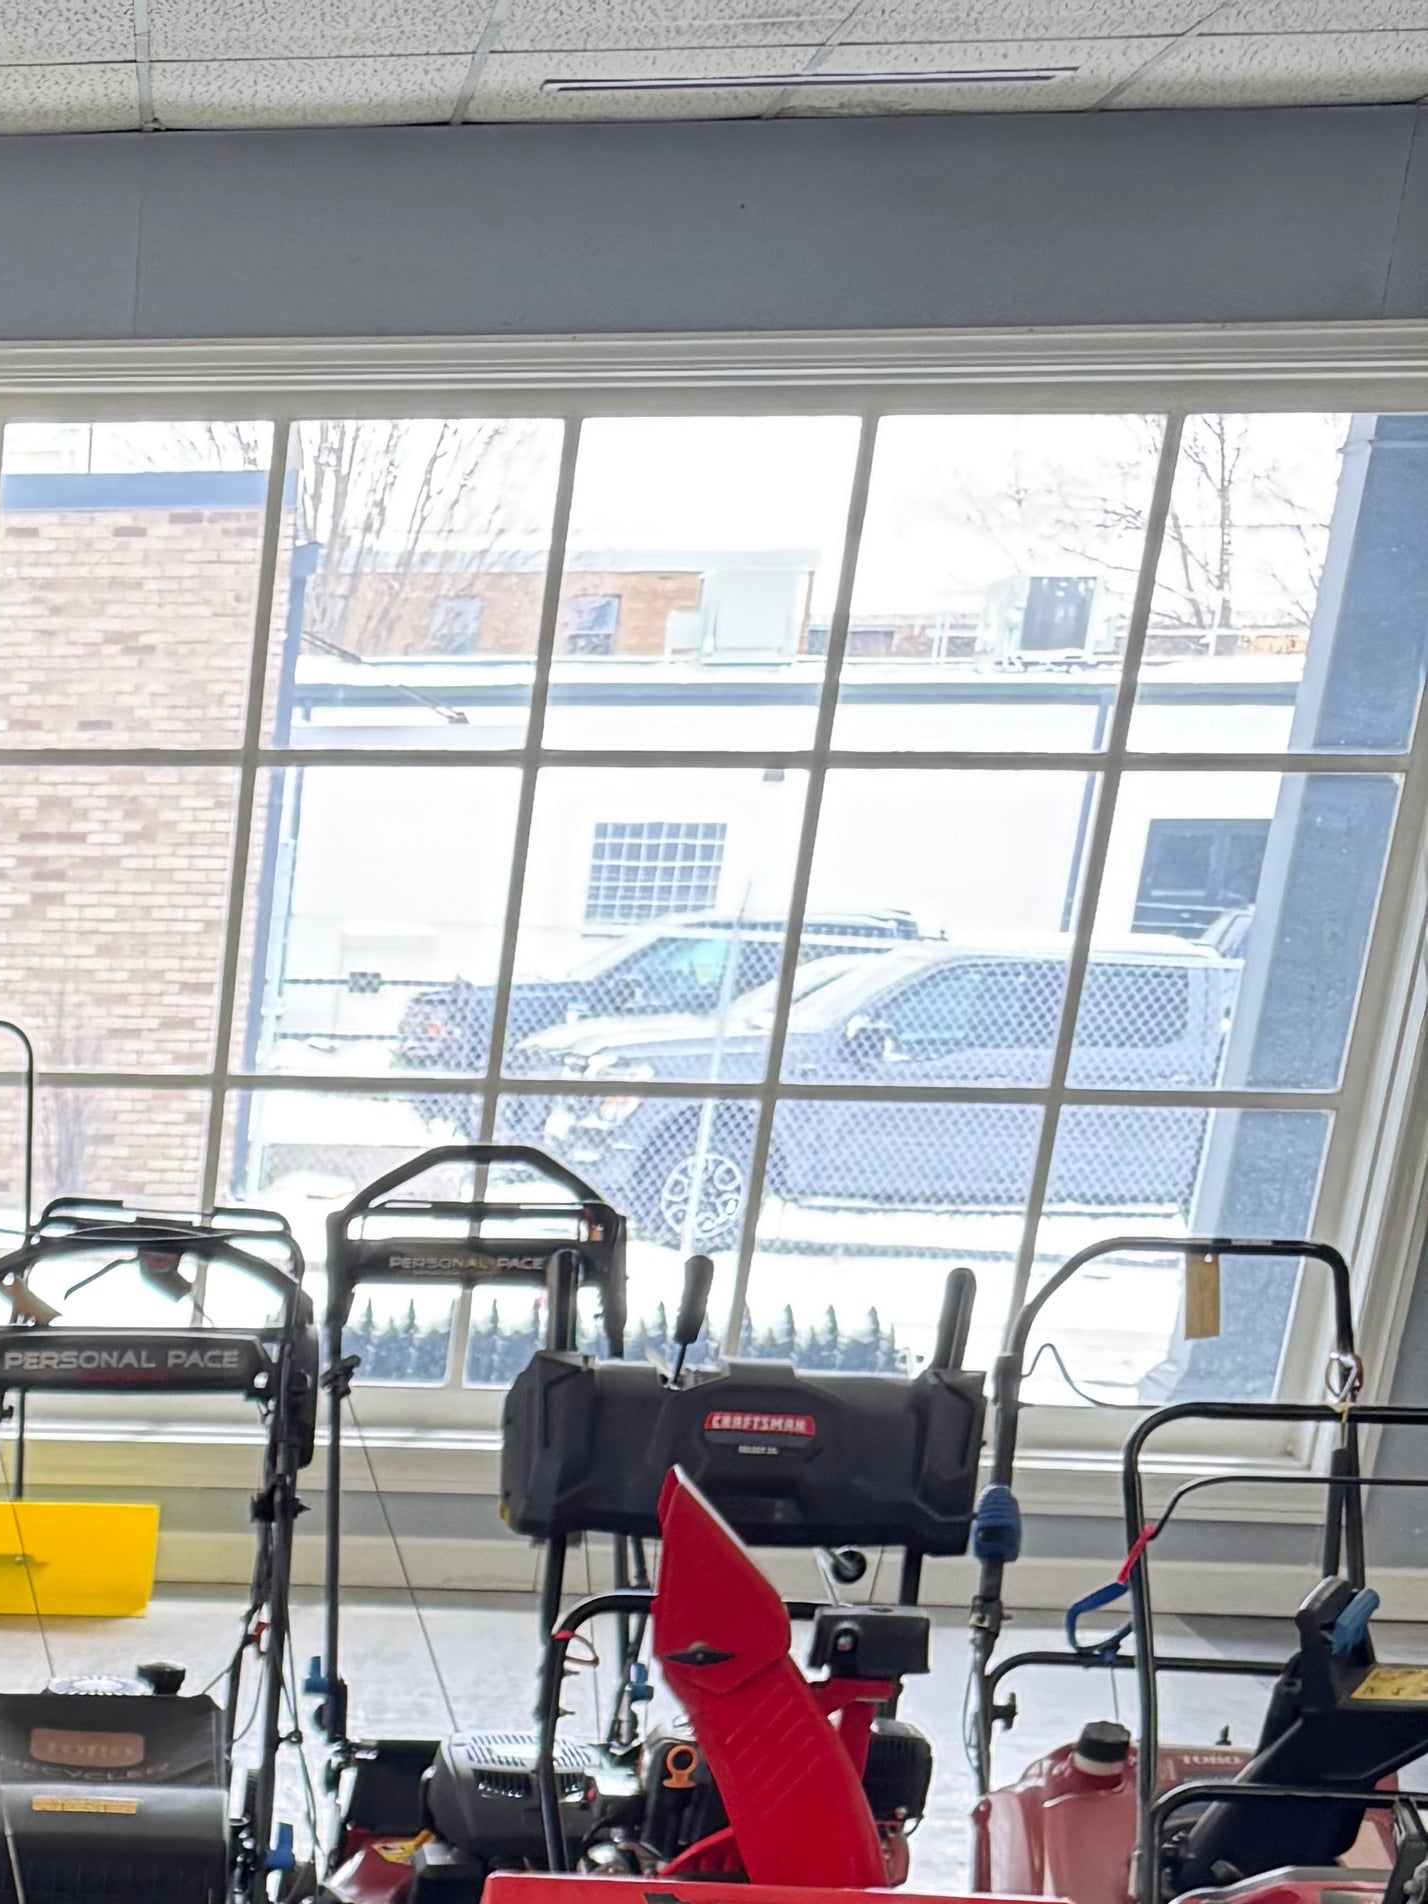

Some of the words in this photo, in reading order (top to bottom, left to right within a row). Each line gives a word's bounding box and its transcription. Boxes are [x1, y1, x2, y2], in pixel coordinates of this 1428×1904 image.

[389, 1256, 489, 1270] PERSONAL
[496, 1257, 545, 1270] PACE
[3, 1350, 156, 1370] PERSONAL
[167, 1350, 240, 1369] PACE
[711, 1414, 806, 1434] CRAFTSMAN
